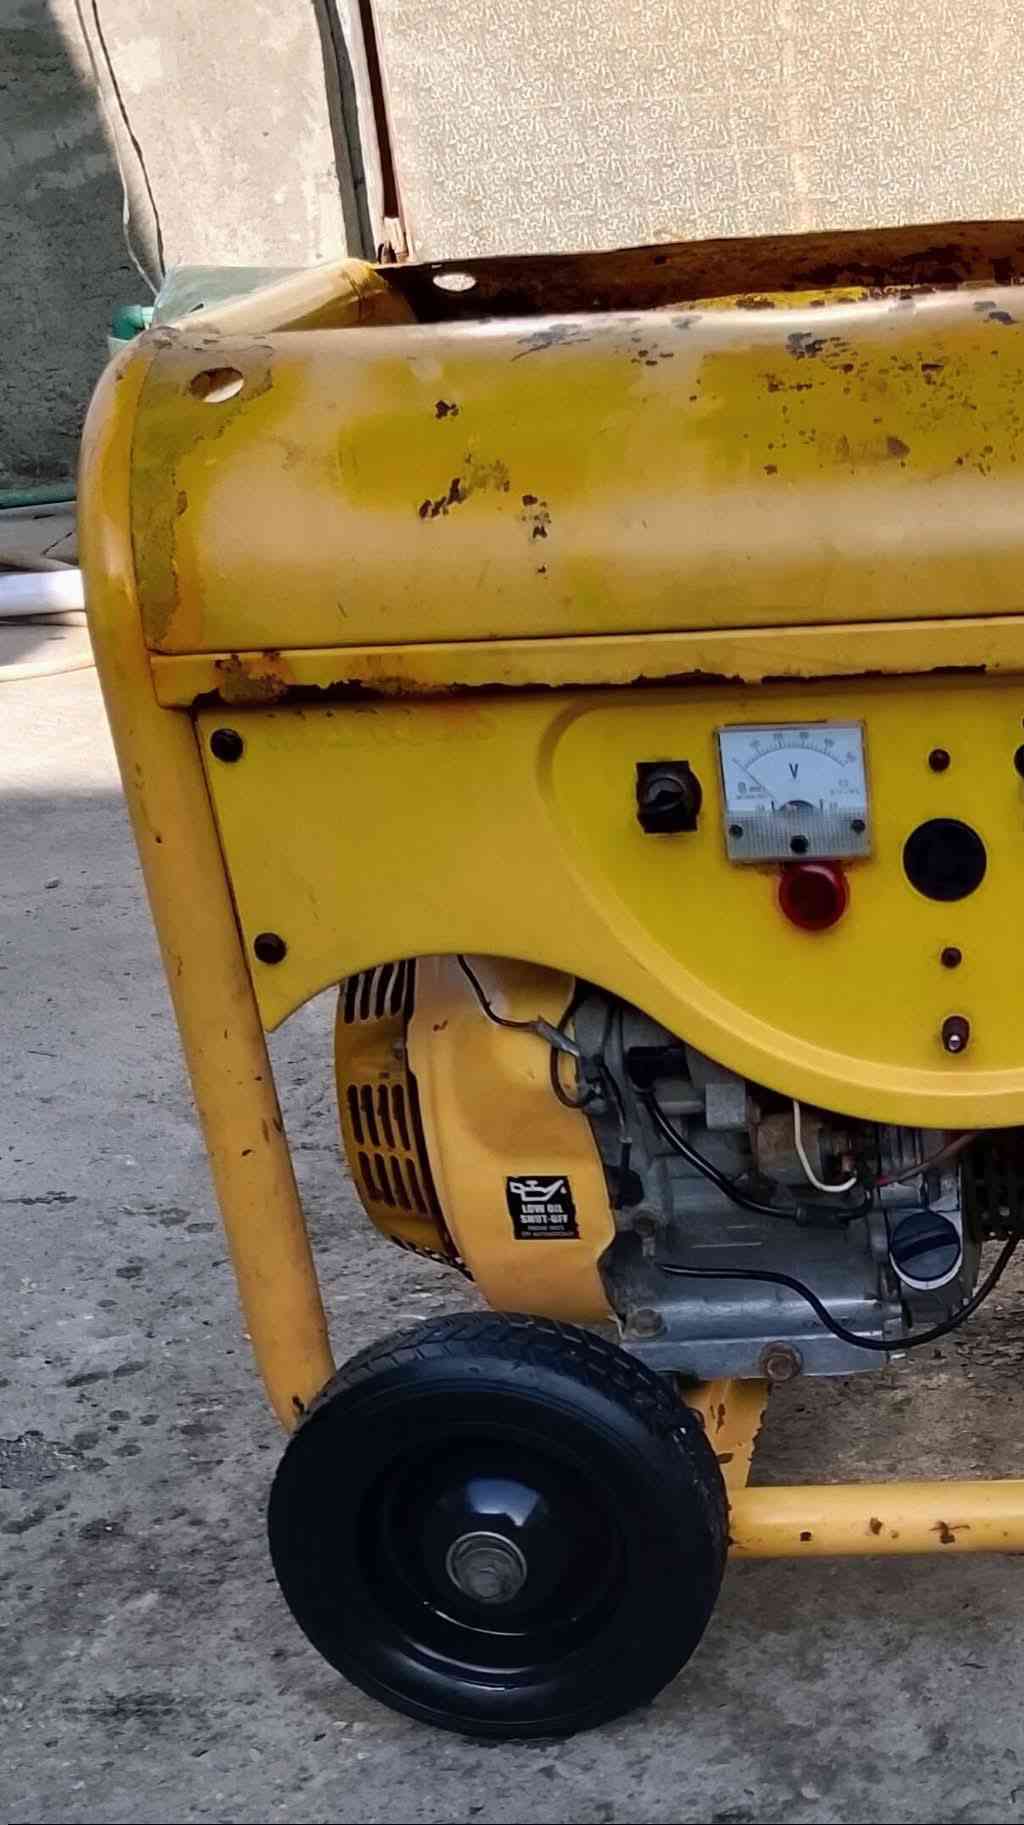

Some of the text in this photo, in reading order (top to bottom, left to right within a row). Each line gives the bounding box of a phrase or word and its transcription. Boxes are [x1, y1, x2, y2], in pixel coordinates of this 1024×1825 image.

[521, 1203, 564, 1213] LOW OIL
[520, 1214, 568, 1224] SHUT-OFF
